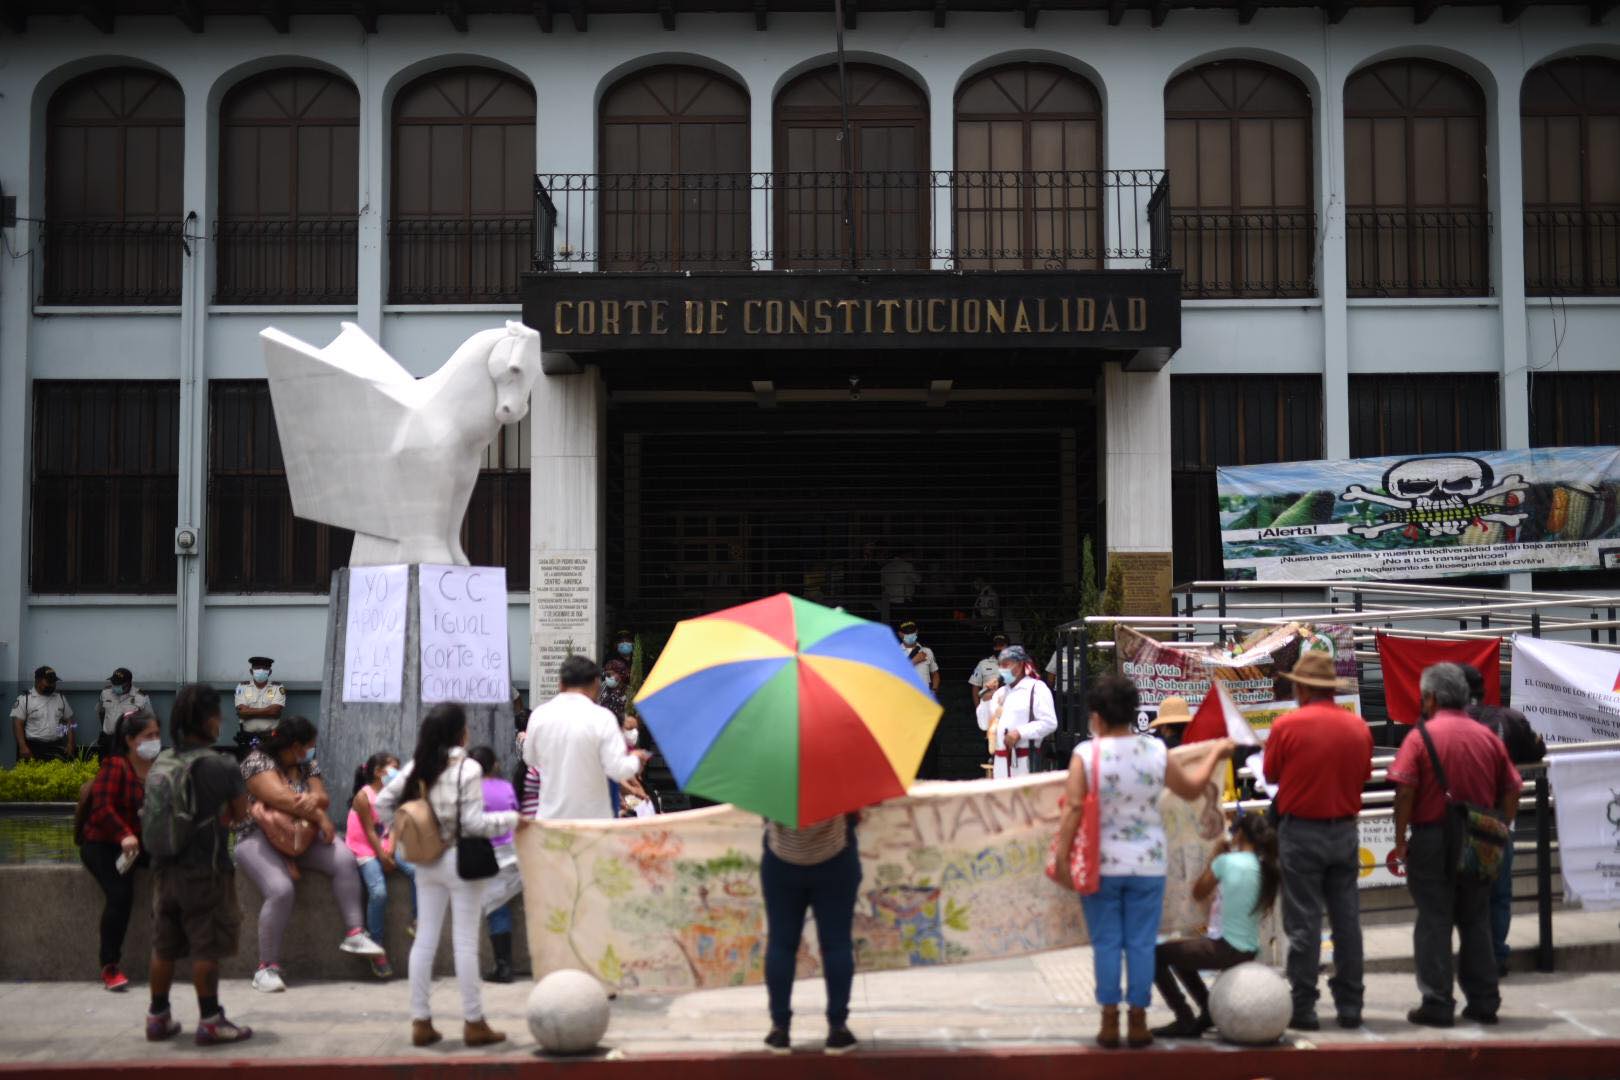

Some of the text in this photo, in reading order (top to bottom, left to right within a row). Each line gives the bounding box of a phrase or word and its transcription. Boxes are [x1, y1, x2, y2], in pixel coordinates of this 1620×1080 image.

[554, 297, 1147, 335] CORTE DE CONSTITUCIONALIDAD
[1258, 525, 1317, 540] ¡Alerta!
[1280, 554, 1329, 564] ¡Nuestras
[1331, 552, 1372, 560] semillas
[1423, 544, 1491, 555] biodiversidad
[1523, 543, 1544, 551] bajo
[1383, 558, 1402, 566] ¡No
[364, 572, 389, 605] YO
[1155, 664, 1181, 676] Vida
[1524, 678, 1534, 687] EL
[1563, 686, 1572, 695] DE
[1573, 687, 1586, 698] LOS
